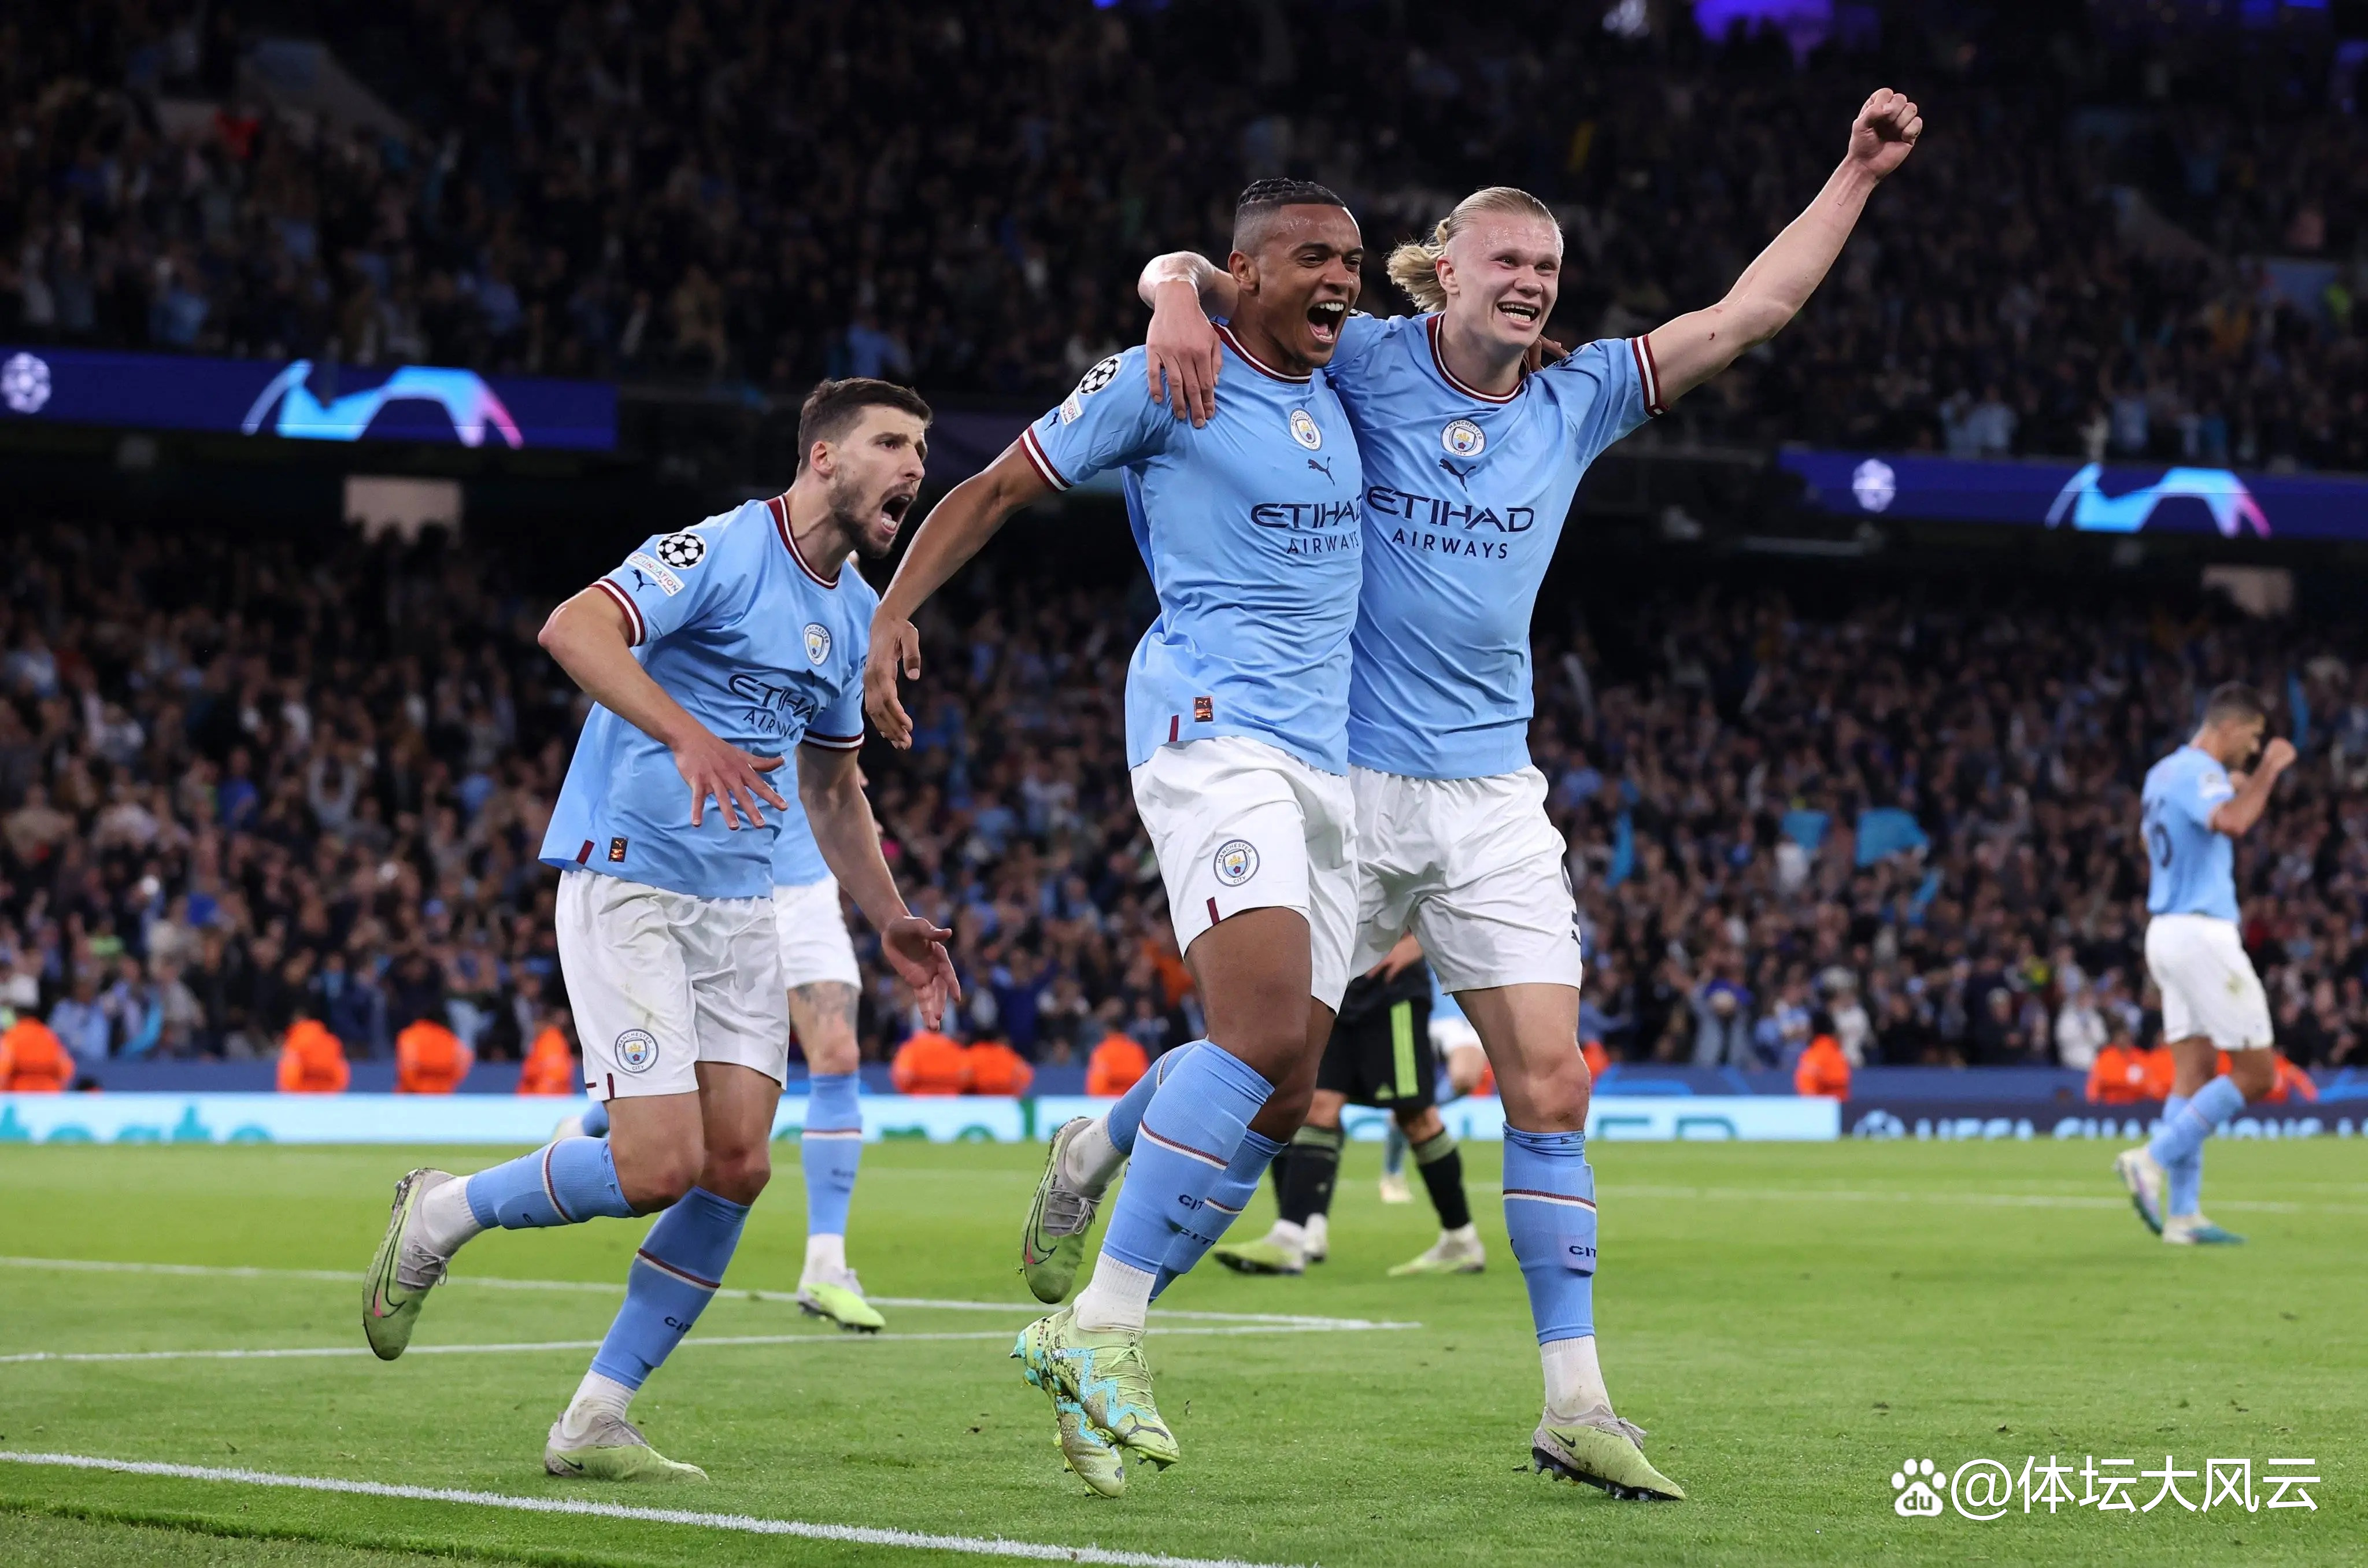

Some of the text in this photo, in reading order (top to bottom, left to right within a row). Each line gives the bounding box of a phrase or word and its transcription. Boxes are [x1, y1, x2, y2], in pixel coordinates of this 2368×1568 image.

[1449, 421, 1482, 439] MANCHESTER
[1367, 485, 1534, 532] ETIHAD
[1286, 531, 1359, 554] AIRWAYS
[1392, 528, 1508, 559] AIRWAYS
[728, 674, 826, 724] ETIHA
[1218, 843, 1252, 863] MANCHESTER
[1233, 875, 1246, 883] CITY
[617, 1032, 653, 1048] MANCHESTER
[1178, 1195, 1205, 1211] CIT
[1568, 1245, 1597, 1258] CIT
[664, 1316, 692, 1333] CIT
